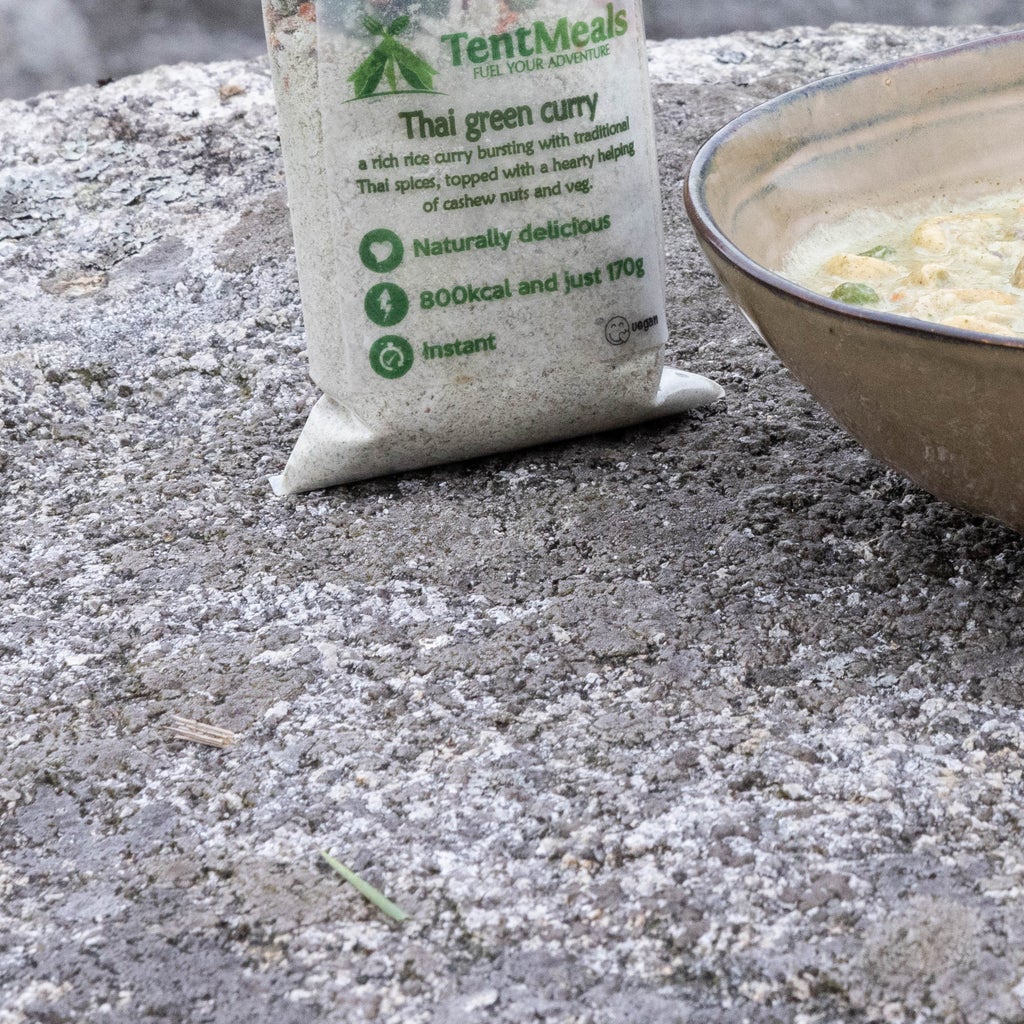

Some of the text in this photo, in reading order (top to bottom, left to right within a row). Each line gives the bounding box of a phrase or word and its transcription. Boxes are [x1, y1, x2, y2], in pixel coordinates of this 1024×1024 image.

[441, 2, 629, 67] TentMeals
[473, 44, 610, 79] FUEL YOUR ADVENTURE
[399, 92, 598, 142] Thai green curry
[356, 141, 635, 195] Thai spices, topped with a hearty helping
[359, 116, 630, 170] a rich rice curry bursting with traditional
[423, 178, 593, 213] of cashew nuts and veg.
[414, 214, 611, 257] Naturally delicious
[420, 256, 645, 309] 800kcal and just 170g
[423, 333, 496, 360] Instant
